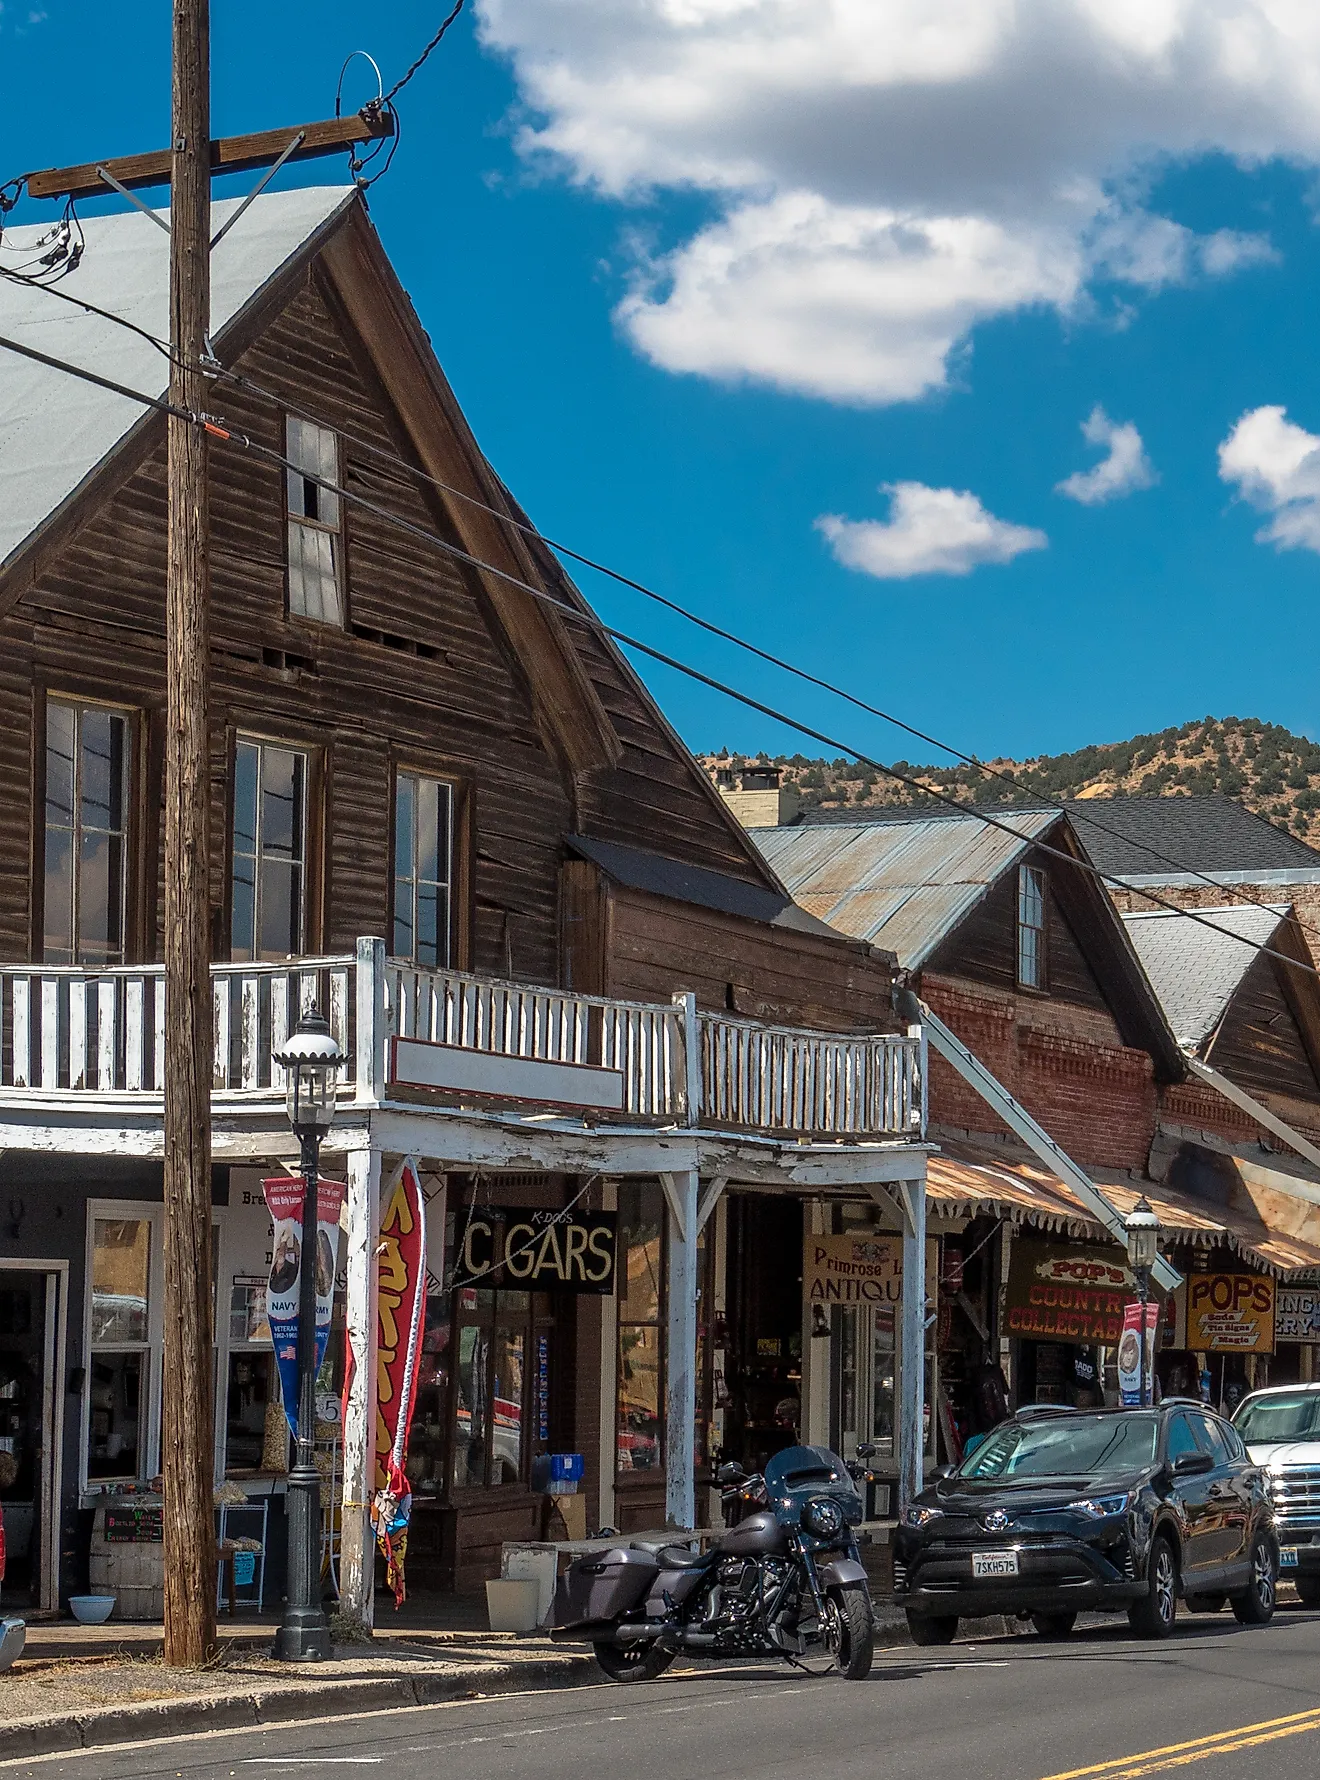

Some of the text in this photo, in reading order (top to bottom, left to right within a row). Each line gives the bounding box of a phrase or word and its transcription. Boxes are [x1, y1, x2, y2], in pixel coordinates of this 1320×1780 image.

[814, 1246, 882, 1277] Primrose
[810, 1278, 929, 1302] ANTIQU
[1192, 1276, 1272, 1313] POPS
[271, 1301, 297, 1311] NAVY
[315, 1305, 329, 1315] RMY
[273, 1325, 298, 1333] VETERAN
[1218, 1336, 1249, 1344] Magic
[975, 1560, 1015, 1574] 7SKH575
